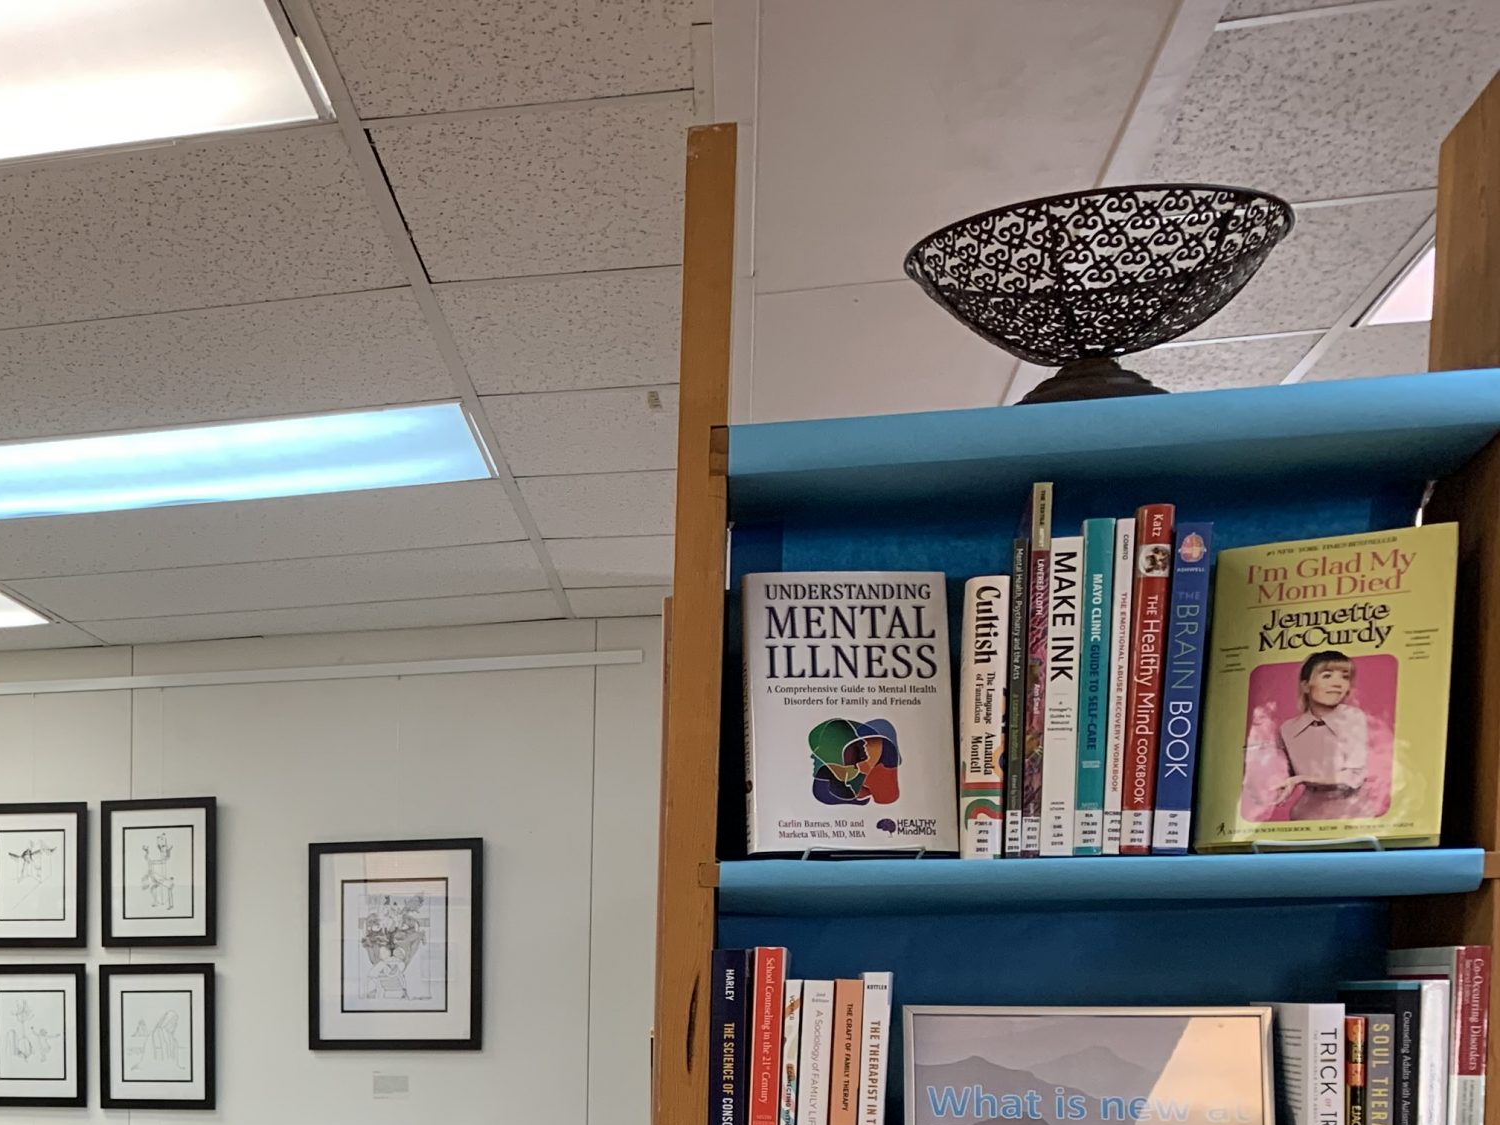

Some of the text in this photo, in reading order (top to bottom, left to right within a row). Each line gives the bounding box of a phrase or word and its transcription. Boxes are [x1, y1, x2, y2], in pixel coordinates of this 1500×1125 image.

[1152, 514, 1164, 537] Katz
[1246, 549, 1416, 585] I'm Glad My
[764, 583, 932, 600] UNDERSTANDING
[1035, 559, 1045, 615] LAYERED CLOTH
[1258, 570, 1402, 604] Mom Died
[1050, 552, 1078, 681] MAKE INK
[1147, 595, 1159, 615] THE
[1263, 602, 1390, 632] Jennette
[765, 605, 936, 640] MENTAL
[973, 586, 1001, 664] Cultish
[1258, 621, 1394, 652] McCurdy
[765, 644, 938, 680] ILLNESS
[1087, 573, 1104, 750] MAYO CLINIC GUIDE TO SELF-CARE
[1134, 619, 1161, 686] Healthy
[766, 685, 938, 696] A Comprehensive Guide to Mental Health
[784, 697, 922, 708] Disorders for Family and Friends
[974, 684, 983, 723] Fanaticism
[983, 672, 996, 724] The Language
[1164, 604, 1200, 778] BRAIN BOOK
[1135, 692, 1156, 734] Mind
[970, 736, 983, 773] Montell
[983, 732, 996, 775] Amanda
[1133, 738, 1149, 804] COOKBOOK
[897, 819, 937, 828] HEALTHY
[897, 827, 937, 836] MindMDs
[725, 969, 735, 1001] HARLEY
[765, 957, 775, 983] School
[761, 986, 774, 1030] Counseling
[1468, 958, 1484, 1070] Co-Occurring Disorders
[723, 1023, 735, 1039] THE
[764, 1031, 772, 1039] in
[845, 1018, 853, 1041] CRAFT
[870, 1020, 881, 1039] THE
[1371, 1024, 1390, 1068] SOUL
[723, 1042, 734, 1080] SCIENCE
[763, 1041, 772, 1054] the
[845, 1043, 851, 1052] OF
[1320, 1028, 1337, 1095] TRICK
[843, 1054, 851, 1077] FAMILY
[867, 1044, 880, 1100] THERAPIST
[1400, 1011, 1413, 1125] Counseling Adults with Autism
[723, 1083, 733, 1095] OF
[759, 1072, 771, 1104] Century
[842, 1080, 850, 1111] THERAPY
[927, 1084, 1042, 1120] What
[1054, 1087, 1087, 1120] is
[1101, 1096, 1189, 1121] new
[867, 1104, 879, 1115] IN
